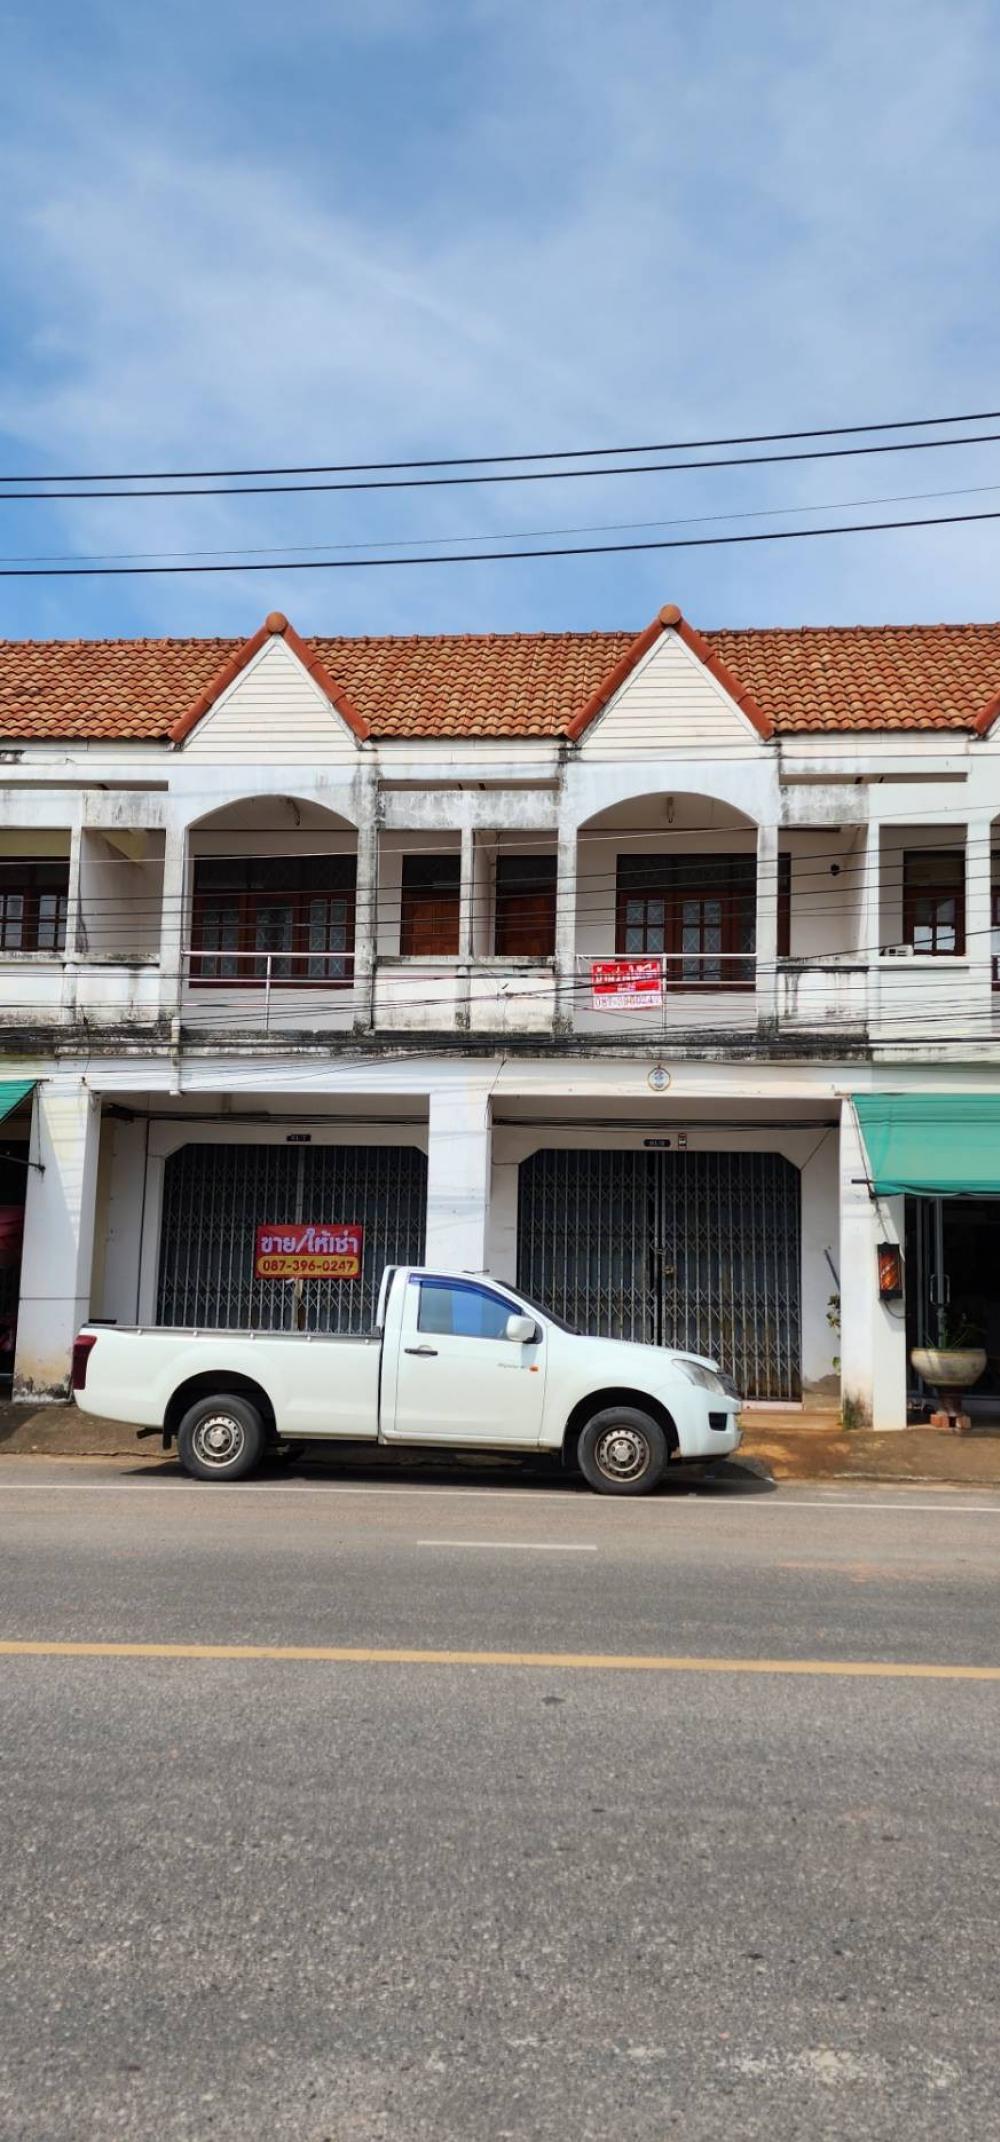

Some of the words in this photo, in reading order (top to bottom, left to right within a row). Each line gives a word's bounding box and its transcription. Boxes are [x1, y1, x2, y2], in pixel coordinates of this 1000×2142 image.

[260, 1227, 359, 1254] ขาย/ให้เช่า
[262, 1259, 355, 1272] 087-396-0247
